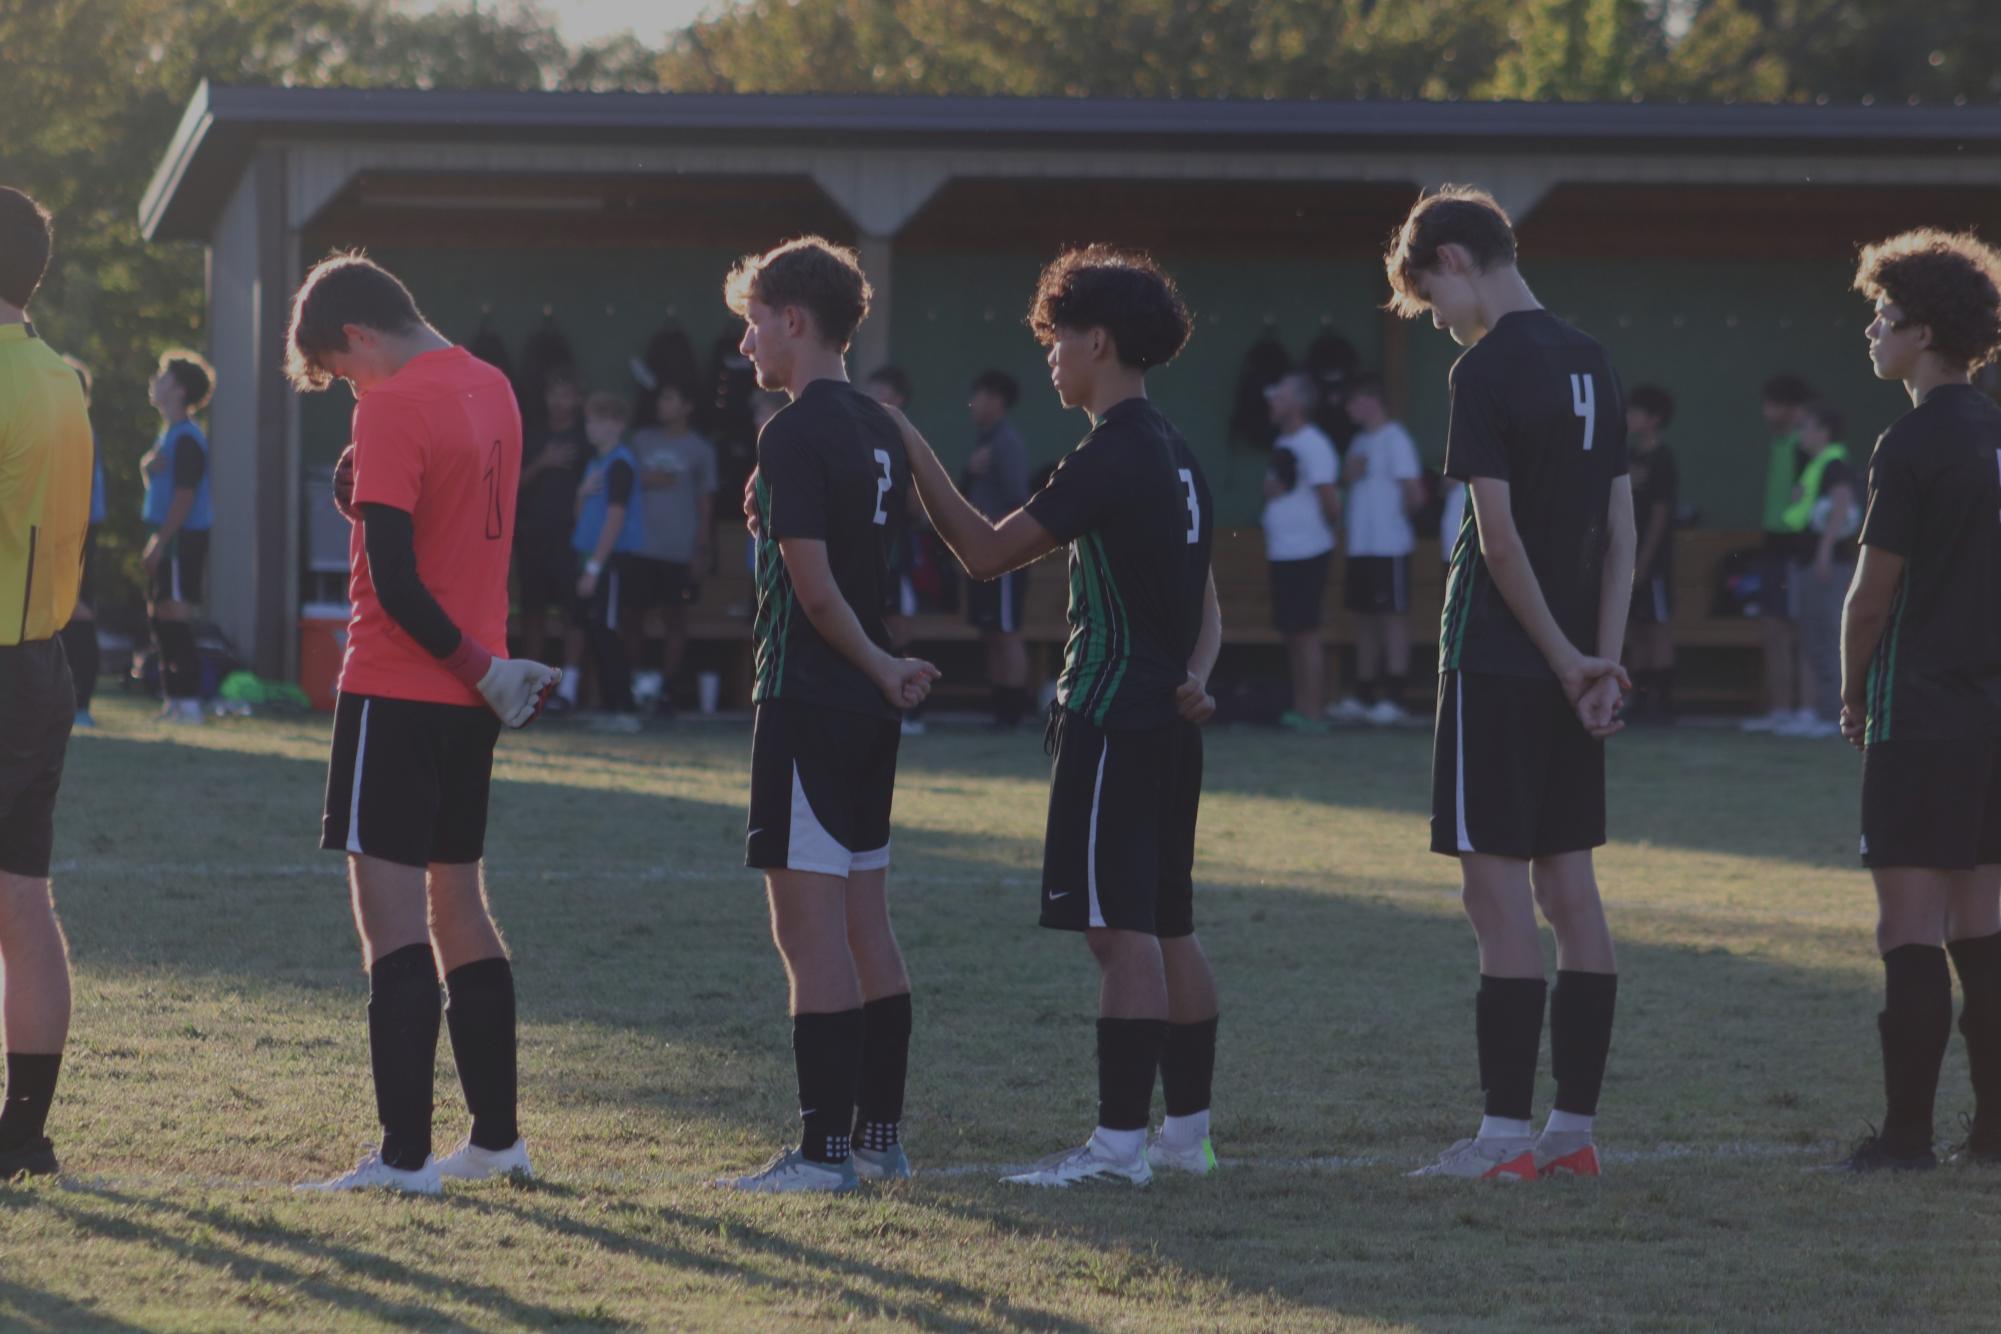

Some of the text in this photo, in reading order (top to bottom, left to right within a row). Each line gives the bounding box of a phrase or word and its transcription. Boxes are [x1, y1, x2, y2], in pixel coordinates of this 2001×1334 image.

[1570, 373, 1595, 451] 4
[483, 440, 502, 540] 1
[873, 448, 892, 526] 2
[1178, 468, 1200, 544] 3
